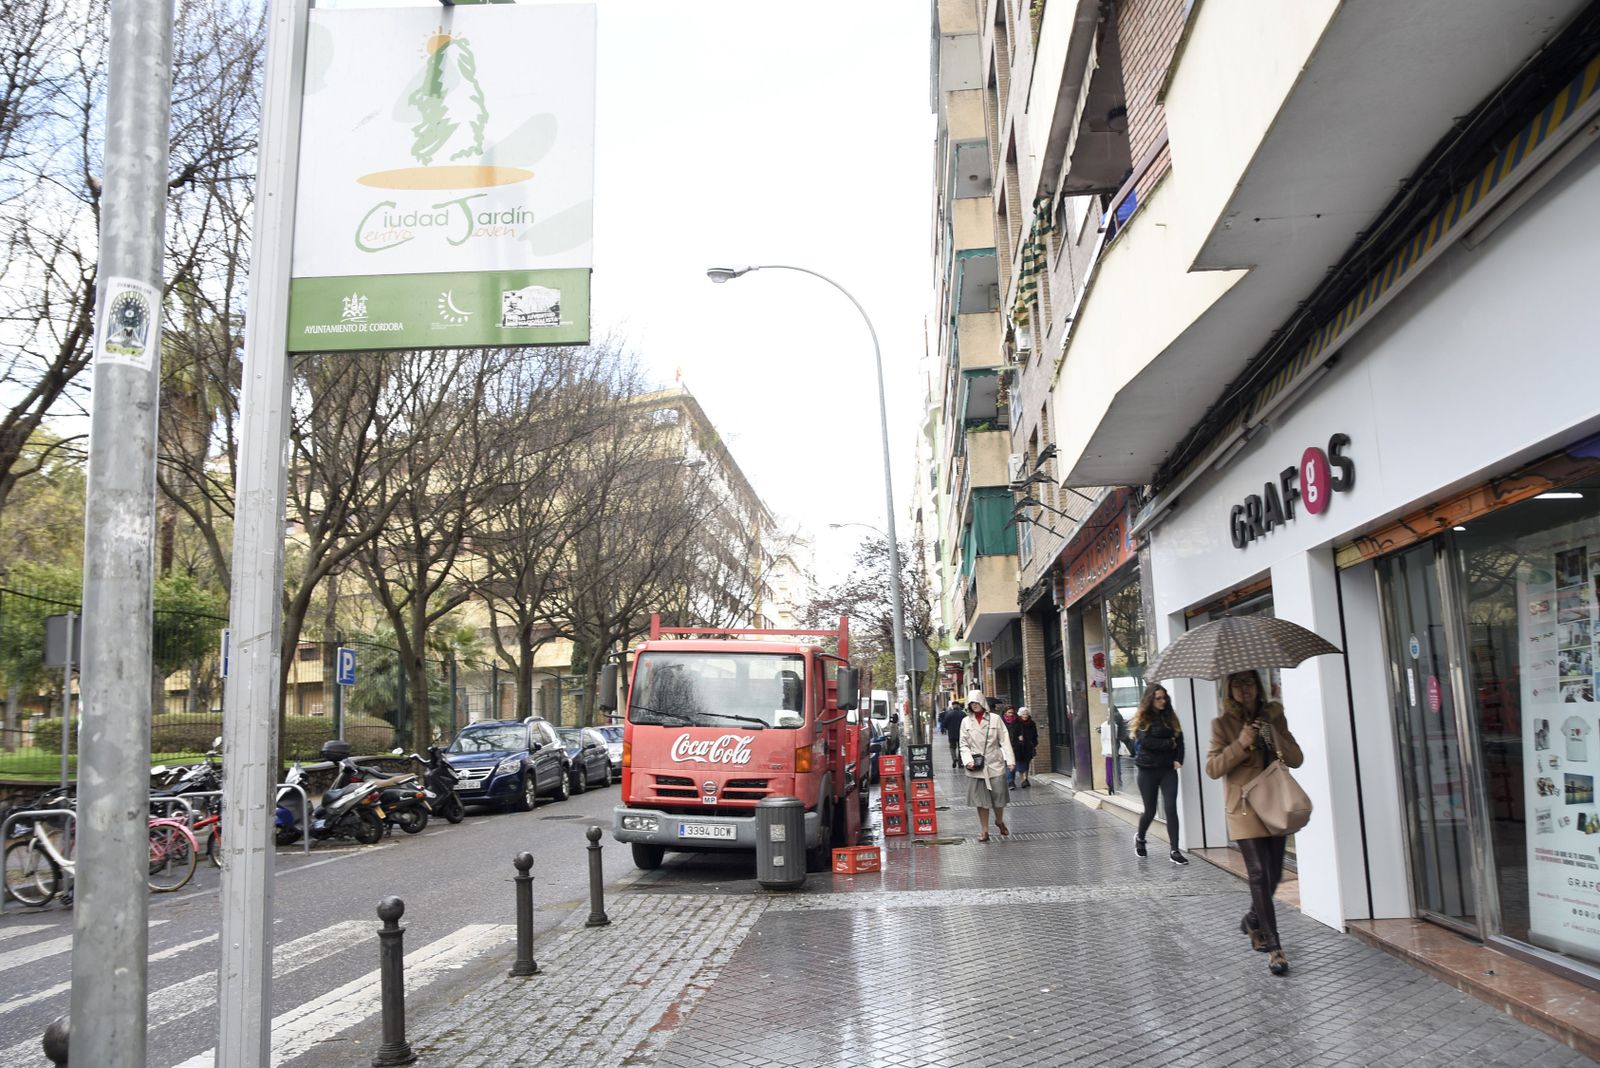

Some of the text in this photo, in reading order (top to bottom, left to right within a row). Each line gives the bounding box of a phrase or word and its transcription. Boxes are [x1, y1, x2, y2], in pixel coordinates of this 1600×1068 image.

[355, 193, 535, 253] Ciudad Jardín
[304, 324, 357, 334] AYUNTAMIENTO
[359, 324, 367, 332] DE
[343, 652, 353, 679] P
[671, 733, 755, 764] Coca-Cola
[687, 826, 732, 837] 3394 DCW
